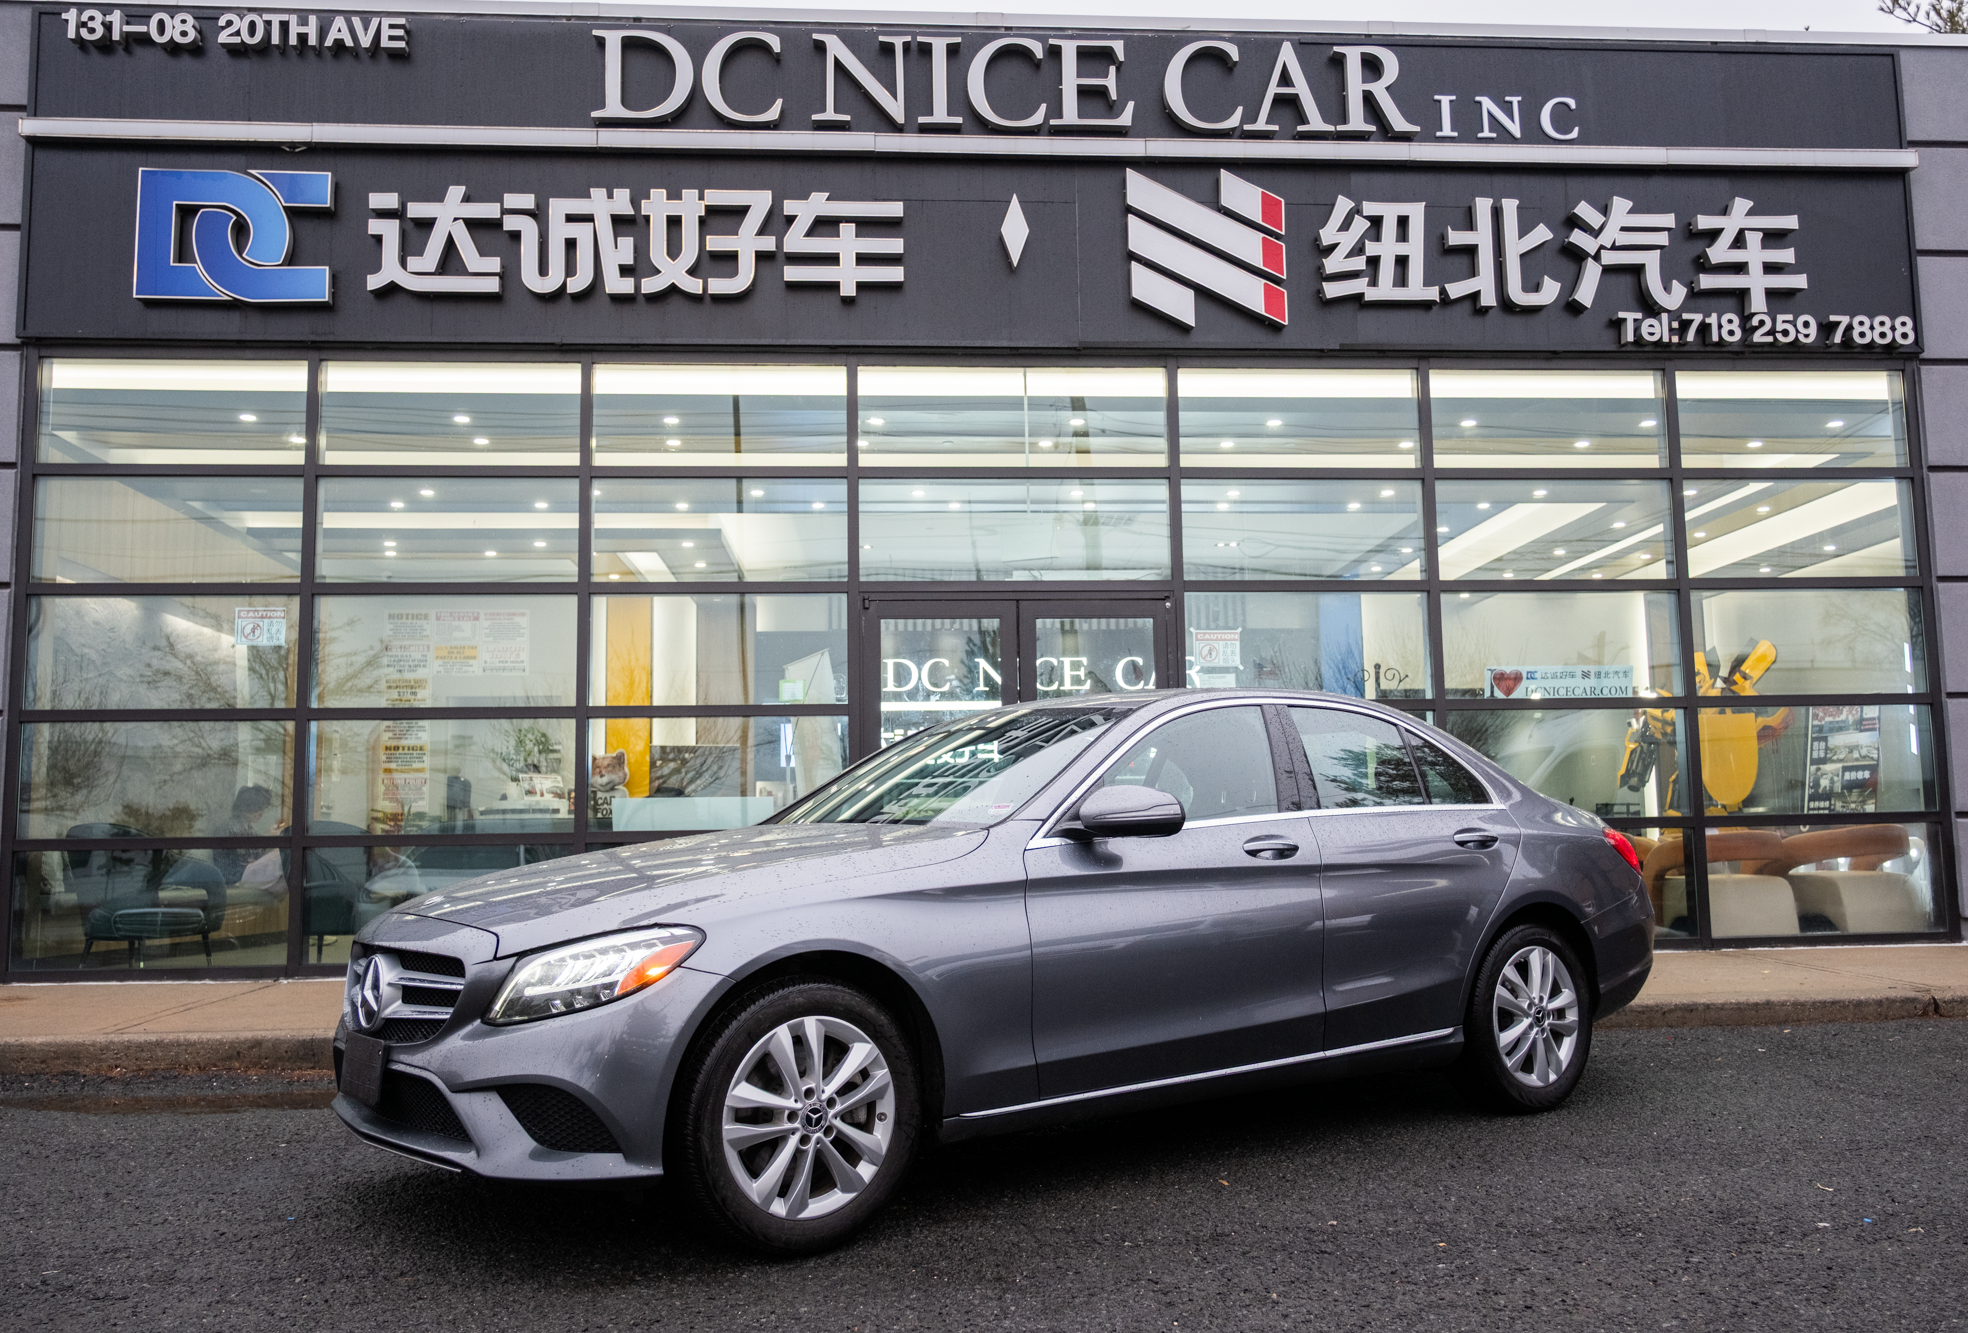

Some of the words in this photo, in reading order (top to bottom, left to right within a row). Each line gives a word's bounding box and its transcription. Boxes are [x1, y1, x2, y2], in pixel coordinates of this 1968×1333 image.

[61, 9, 200, 48] 131-08
[218, 13, 319, 52] 20TH
[324, 16, 409, 55] AVE
[591, 29, 783, 127] DC
[811, 34, 1134, 131] NICE
[1163, 39, 1420, 138] CAR
[1434, 95, 1579, 140] INC
[367, 186, 905, 298] 达诚好车
[1318, 195, 1808, 314] 纽北汽车
[1752, 313, 1817, 345] 259
[1829, 315, 1916, 347] 7888
[240, 610, 284, 618] CAUTION
[388, 612, 430, 621] NOTICE
[882, 658, 951, 692] DC
[974, 657, 1091, 691] NCE
[1525, 685, 1629, 698] DCNICECAR.COM
[1540, 671, 1577, 680] 达诚好车
[1594, 671, 1630, 680] 纽北汽车
[1844, 770, 1871, 781] 高价收车
